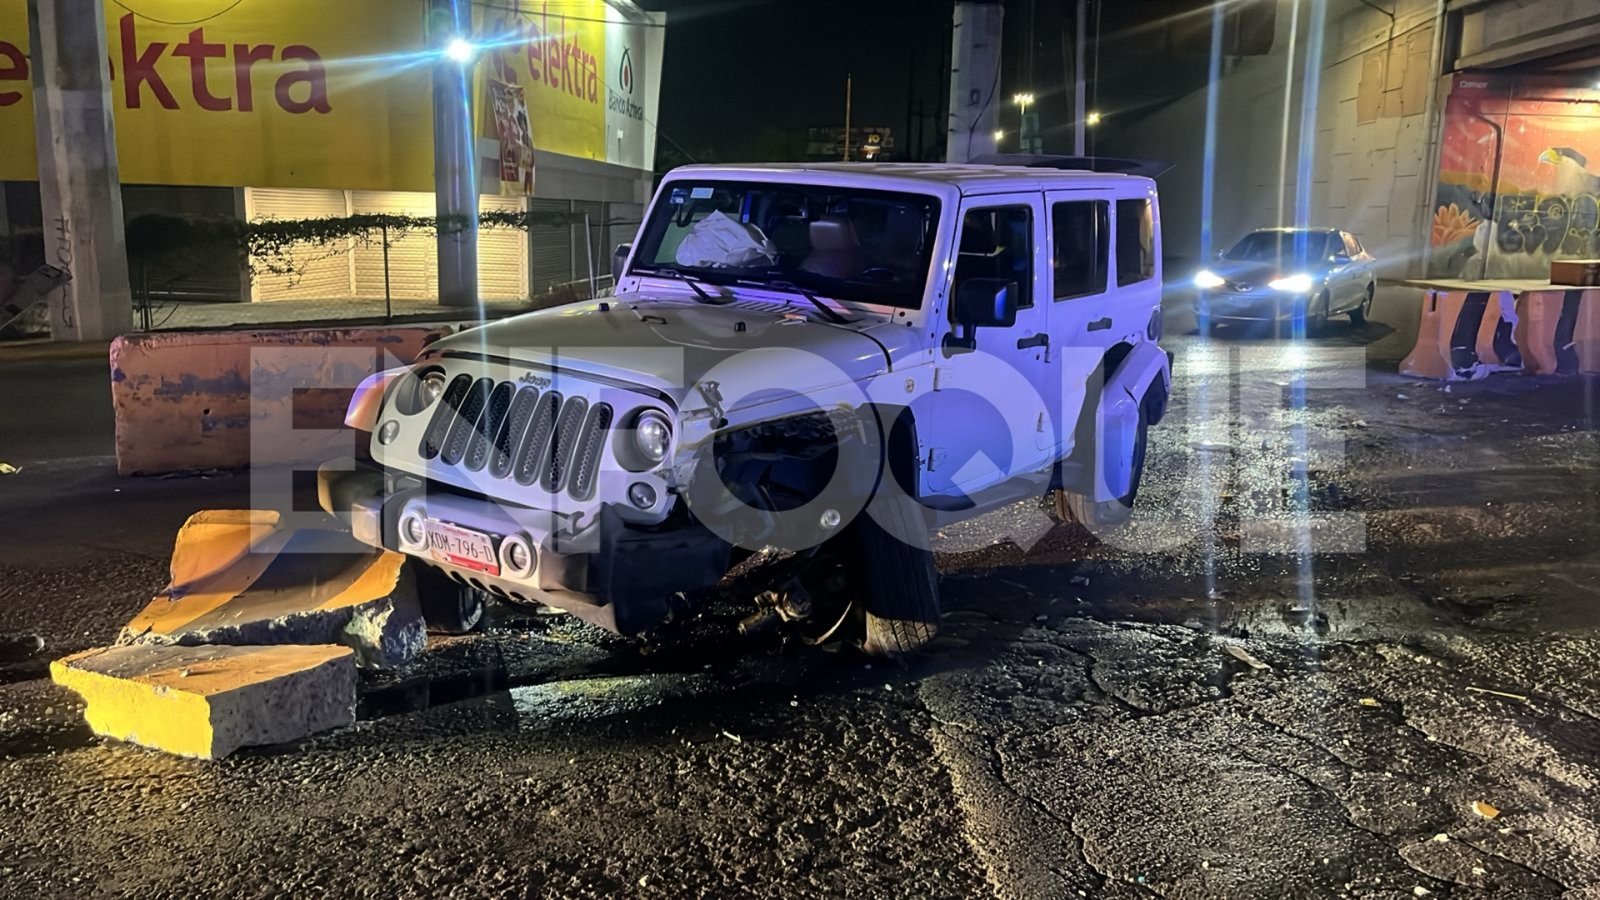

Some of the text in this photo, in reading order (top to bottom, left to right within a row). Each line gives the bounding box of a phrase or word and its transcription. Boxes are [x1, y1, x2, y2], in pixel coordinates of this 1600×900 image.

[0, 12, 333, 114] ektra
[528, 0, 598, 104] elektra
[519, 371, 551, 390] Jeep
[428, 531, 493, 562] XDM-796-D
